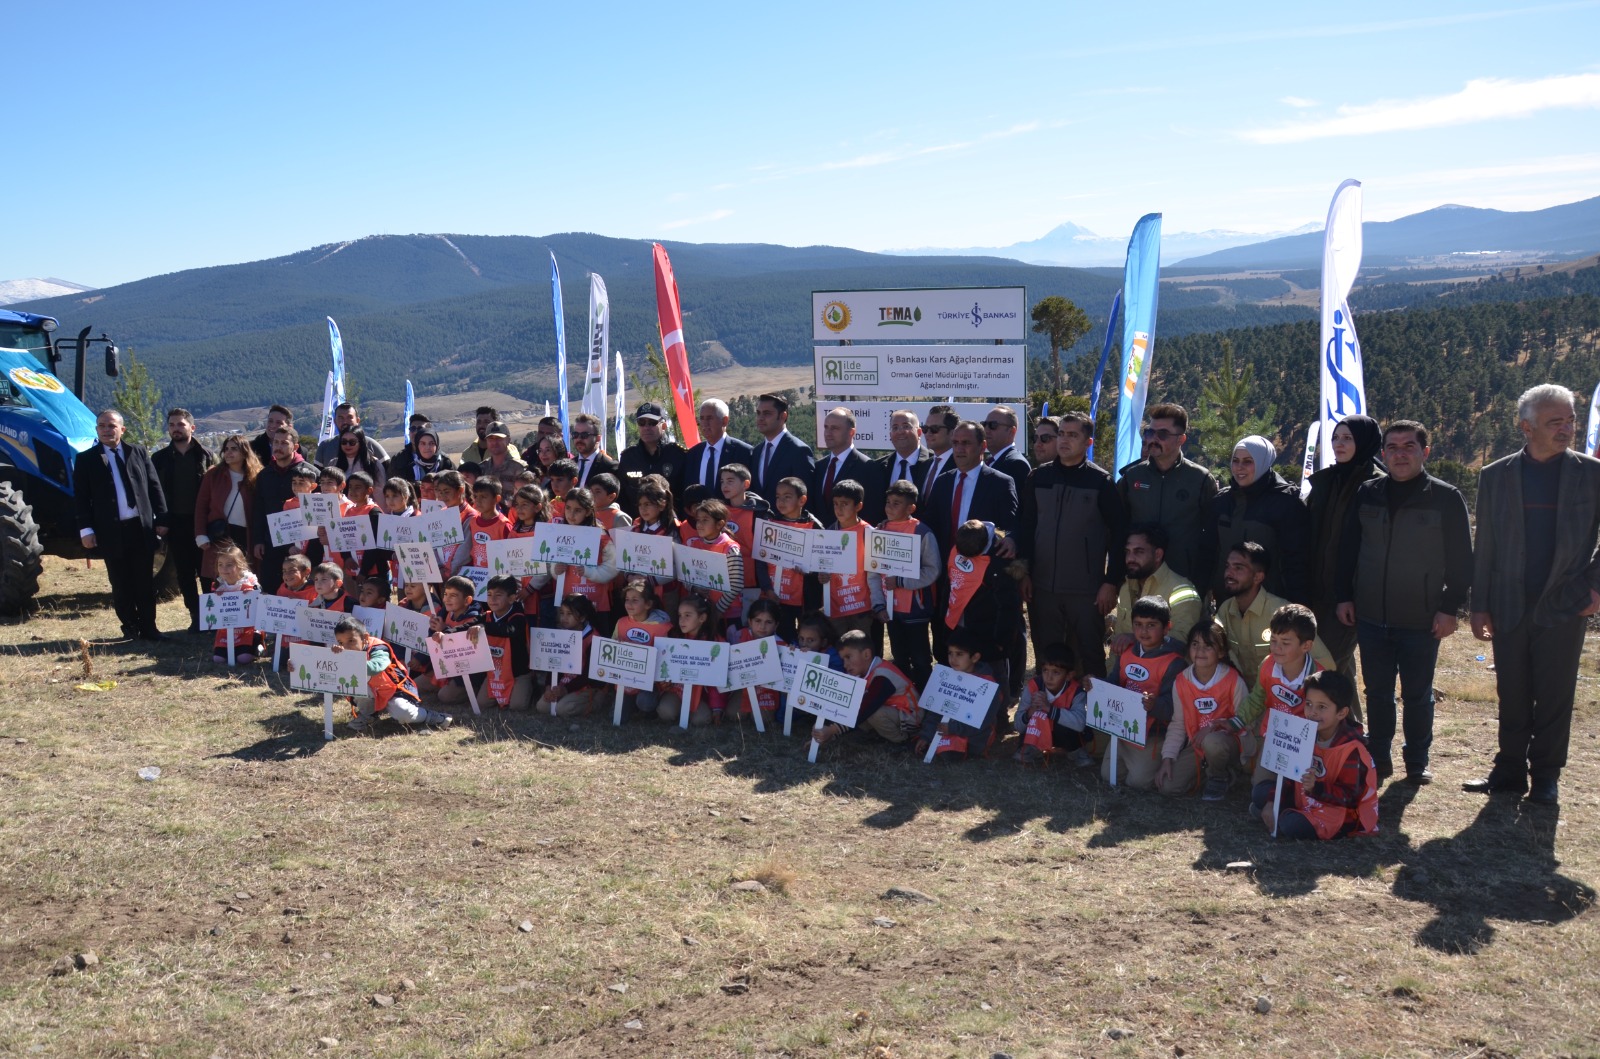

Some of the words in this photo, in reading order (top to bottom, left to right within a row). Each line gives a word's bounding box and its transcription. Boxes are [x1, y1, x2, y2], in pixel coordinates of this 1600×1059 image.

[879, 307, 912, 321] TEMA
[937, 311, 970, 319] TÜRKİYE
[983, 311, 1017, 319] BANKASI
[843, 360, 861, 370] ilde
[887, 354, 894, 364] İş
[896, 355, 927, 363] Bankası
[929, 355, 947, 363] Kars
[949, 355, 1014, 365] Ağaçlandırması
[843, 373, 876, 381] orman
[890, 371, 913, 379] Orman
[914, 371, 934, 379] Genel
[935, 371, 972, 380] Müdürlüğü
[973, 371, 1010, 379] Tarafından
[396, 526, 412, 536] KARS
[428, 520, 443, 531] KARS
[556, 535, 576, 545] KARS
[778, 530, 792, 541] ilde
[777, 541, 802, 553] orman
[886, 536, 900, 547] ilde
[506, 548, 524, 558] KARS
[634, 544, 652, 555] KARS
[886, 549, 911, 559] orman
[691, 558, 708, 570] KARS
[571, 585, 597, 593] TÜRKİYE
[837, 585, 861, 597] TÜRKİYE
[843, 594, 856, 605] ÇÖL
[839, 601, 866, 613] OLMASIN
[402, 619, 419, 631] KARS
[631, 629, 645, 639] TEMA
[617, 646, 634, 658] ilde
[316, 660, 339, 672] KARS
[616, 659, 644, 671] orman
[1129, 665, 1142, 675] TEMA
[823, 674, 839, 687] ilde
[819, 687, 849, 703] orman
[940, 681, 967, 694] GELECEĞİMİZ
[967, 689, 978, 698] İÇİN
[1278, 687, 1294, 702] TEMA
[958, 694, 975, 704] ORMAN
[1197, 700, 1213, 708] TEMA
[1107, 698, 1124, 714] KARS
[1293, 736, 1302, 745] İÇİN
[1286, 743, 1301, 754] ORMAN
